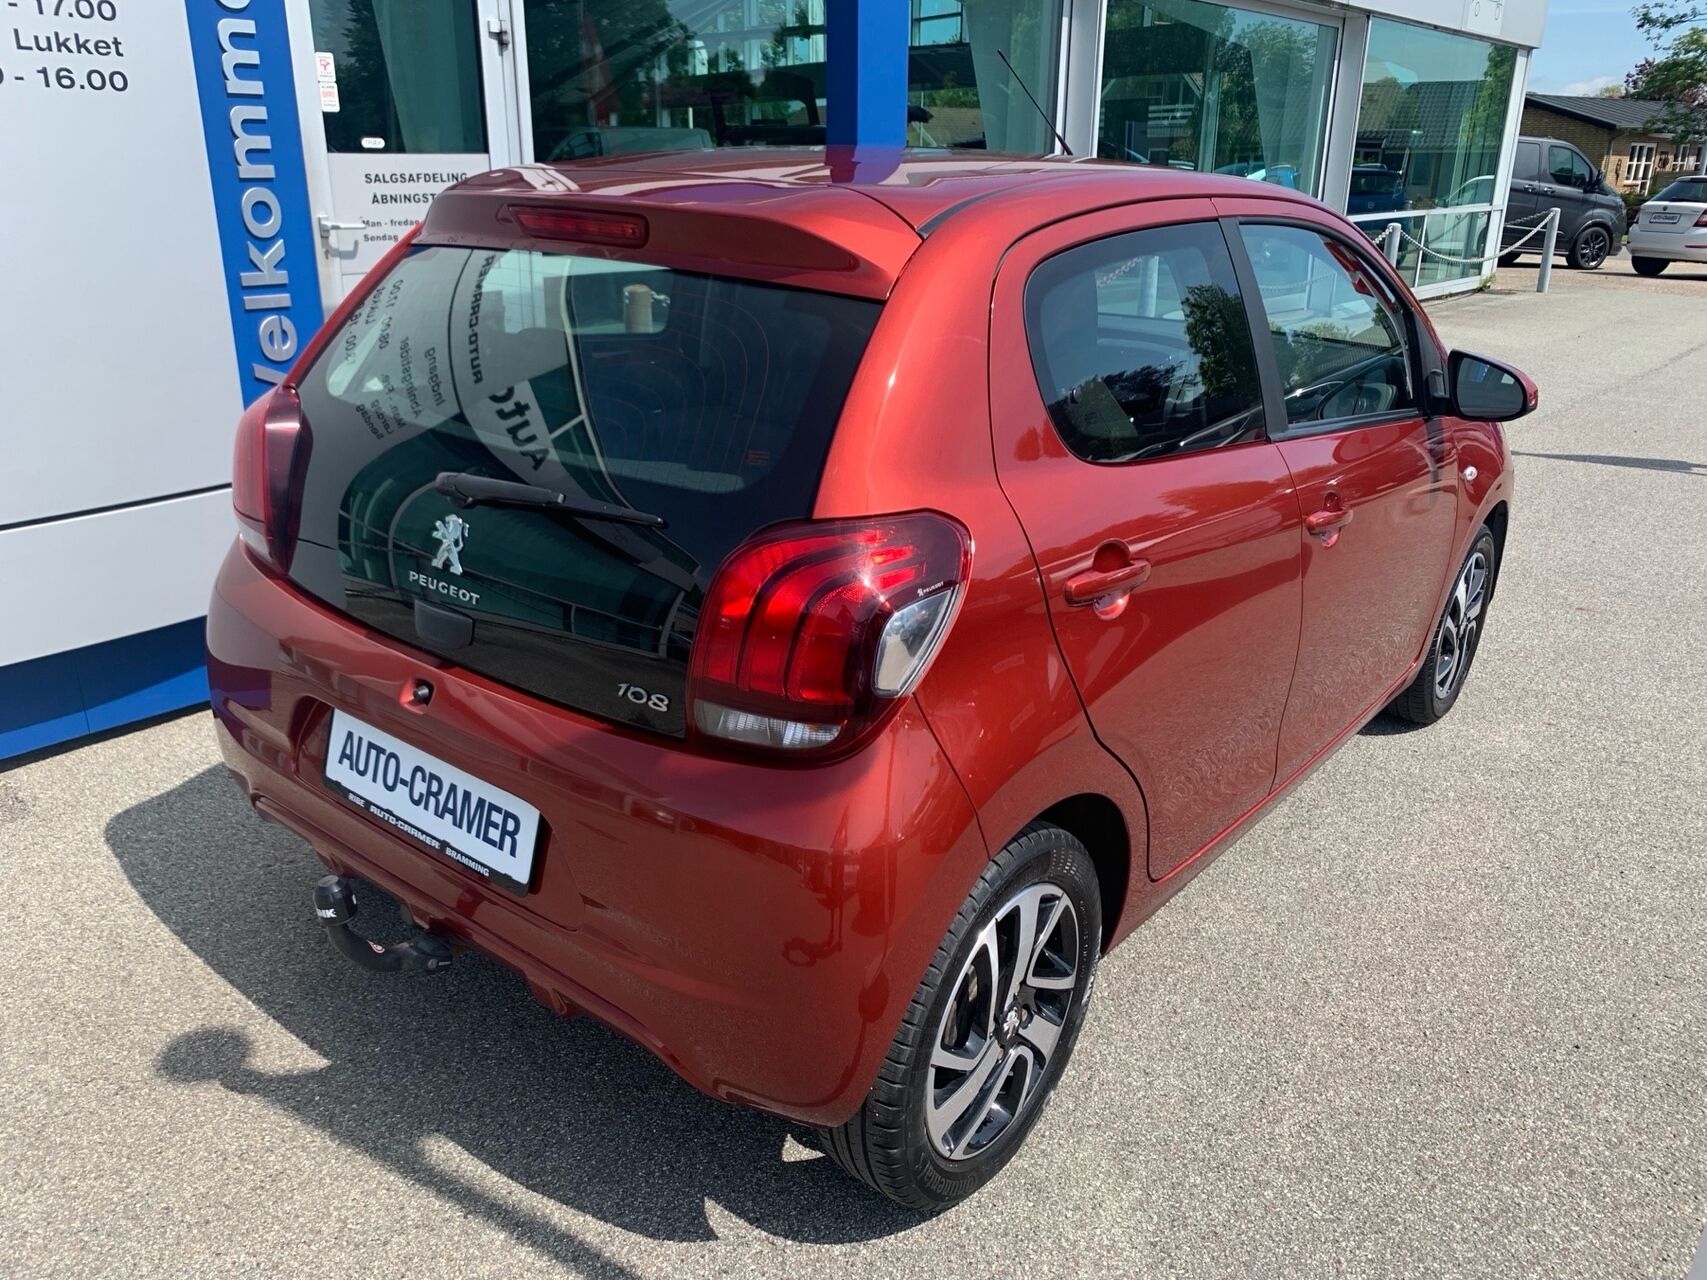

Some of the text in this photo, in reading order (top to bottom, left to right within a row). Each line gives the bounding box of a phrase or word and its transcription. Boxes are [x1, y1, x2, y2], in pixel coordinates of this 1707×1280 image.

[13, 28, 124, 57] Lukket
[36, 66, 128, 92] 16.00
[215, 0, 298, 386] elkomm
[408, 570, 481, 605] PEUGEOT
[617, 682, 670, 713] 108
[338, 730, 522, 858] AUTO-CRAMER
[369, 804, 441, 850] AUTO-CRAMER
[445, 847, 490, 877] BRAMMING
